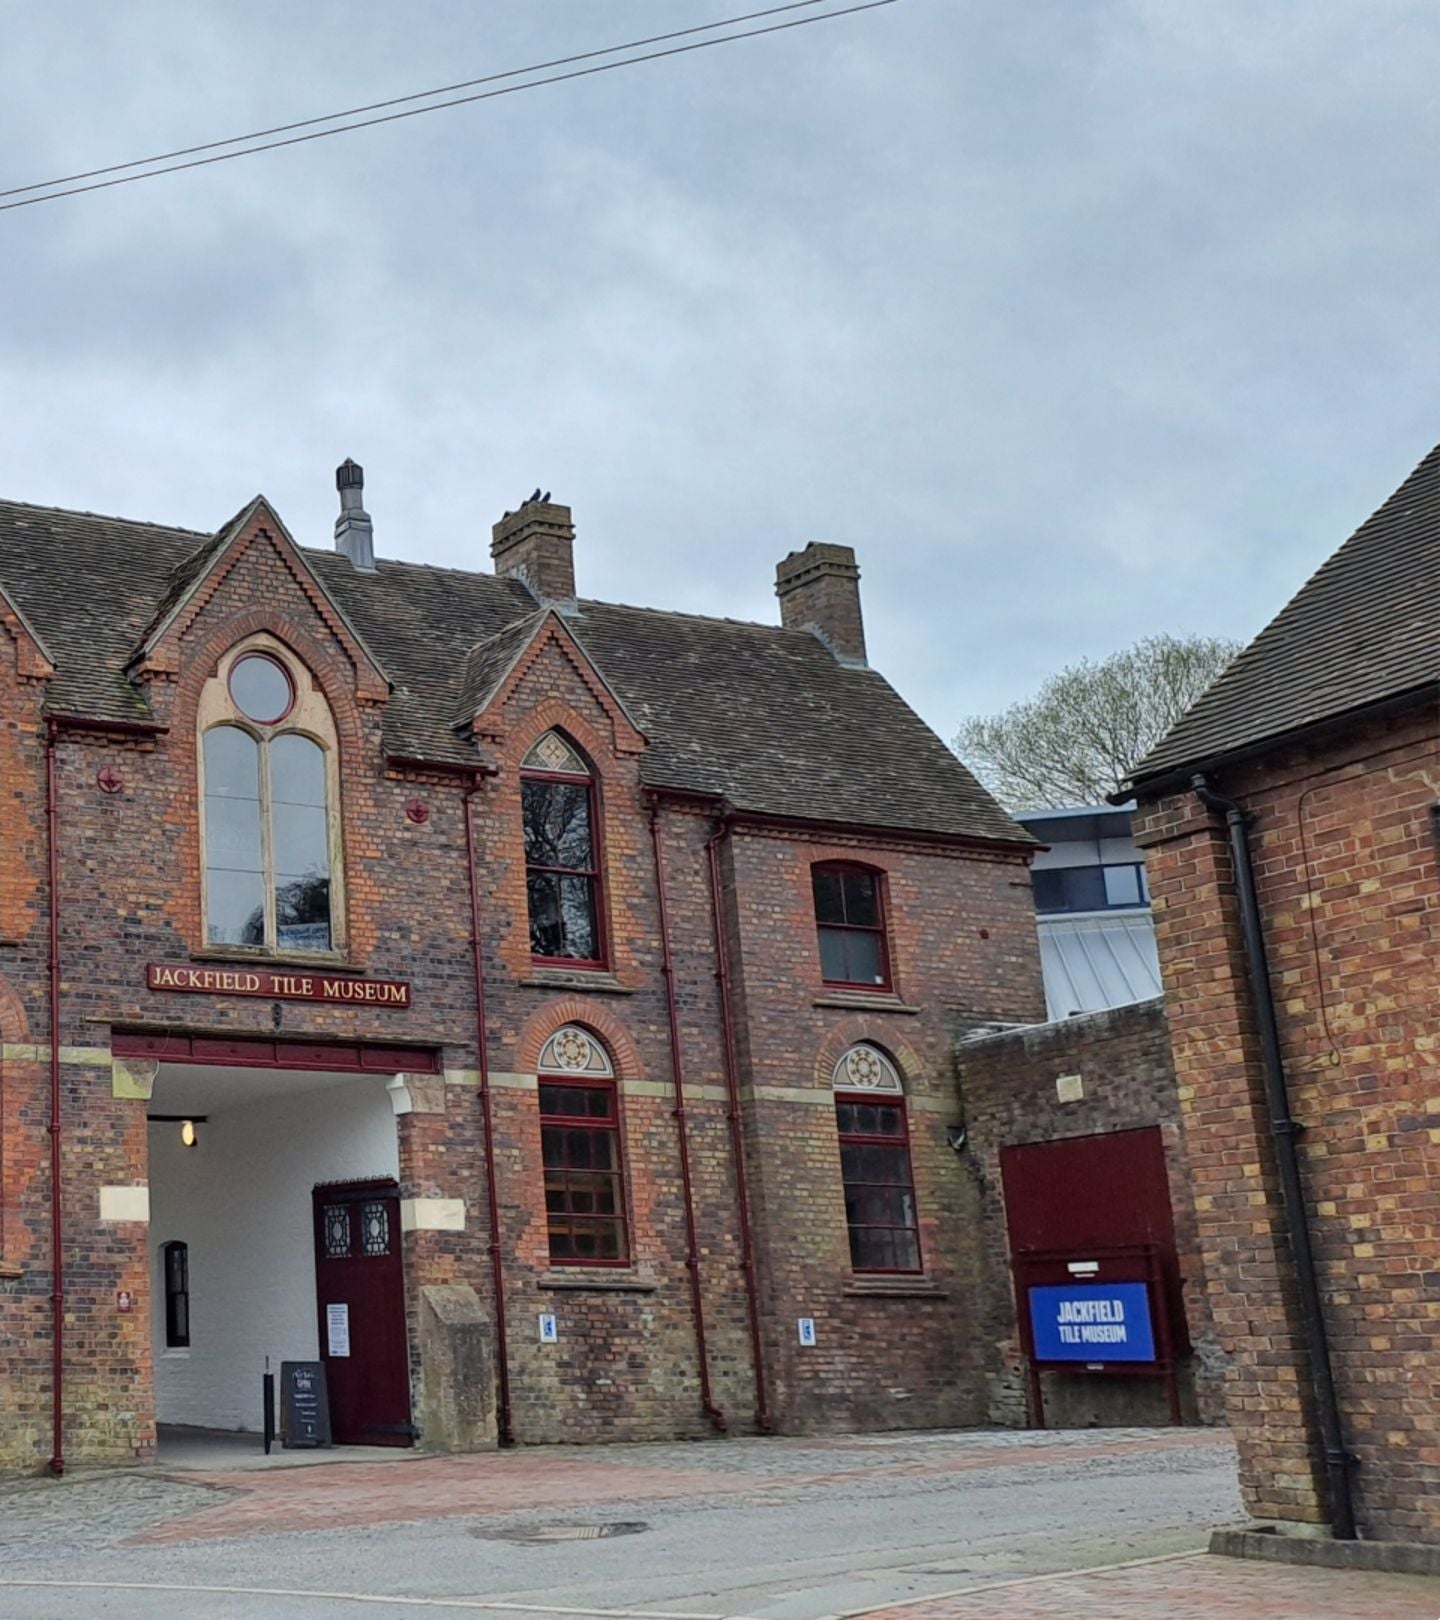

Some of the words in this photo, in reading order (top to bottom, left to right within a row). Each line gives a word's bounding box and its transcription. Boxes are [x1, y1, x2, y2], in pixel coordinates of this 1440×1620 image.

[153, 967, 260, 991] JACKFIELD
[270, 975, 313, 996] TILE
[323, 980, 407, 1002] MUSEUM
[1056, 1299, 1125, 1324] JACKFIELD
[1057, 1325, 1081, 1343] TILE
[1081, 1324, 1127, 1343] MUSEUM
